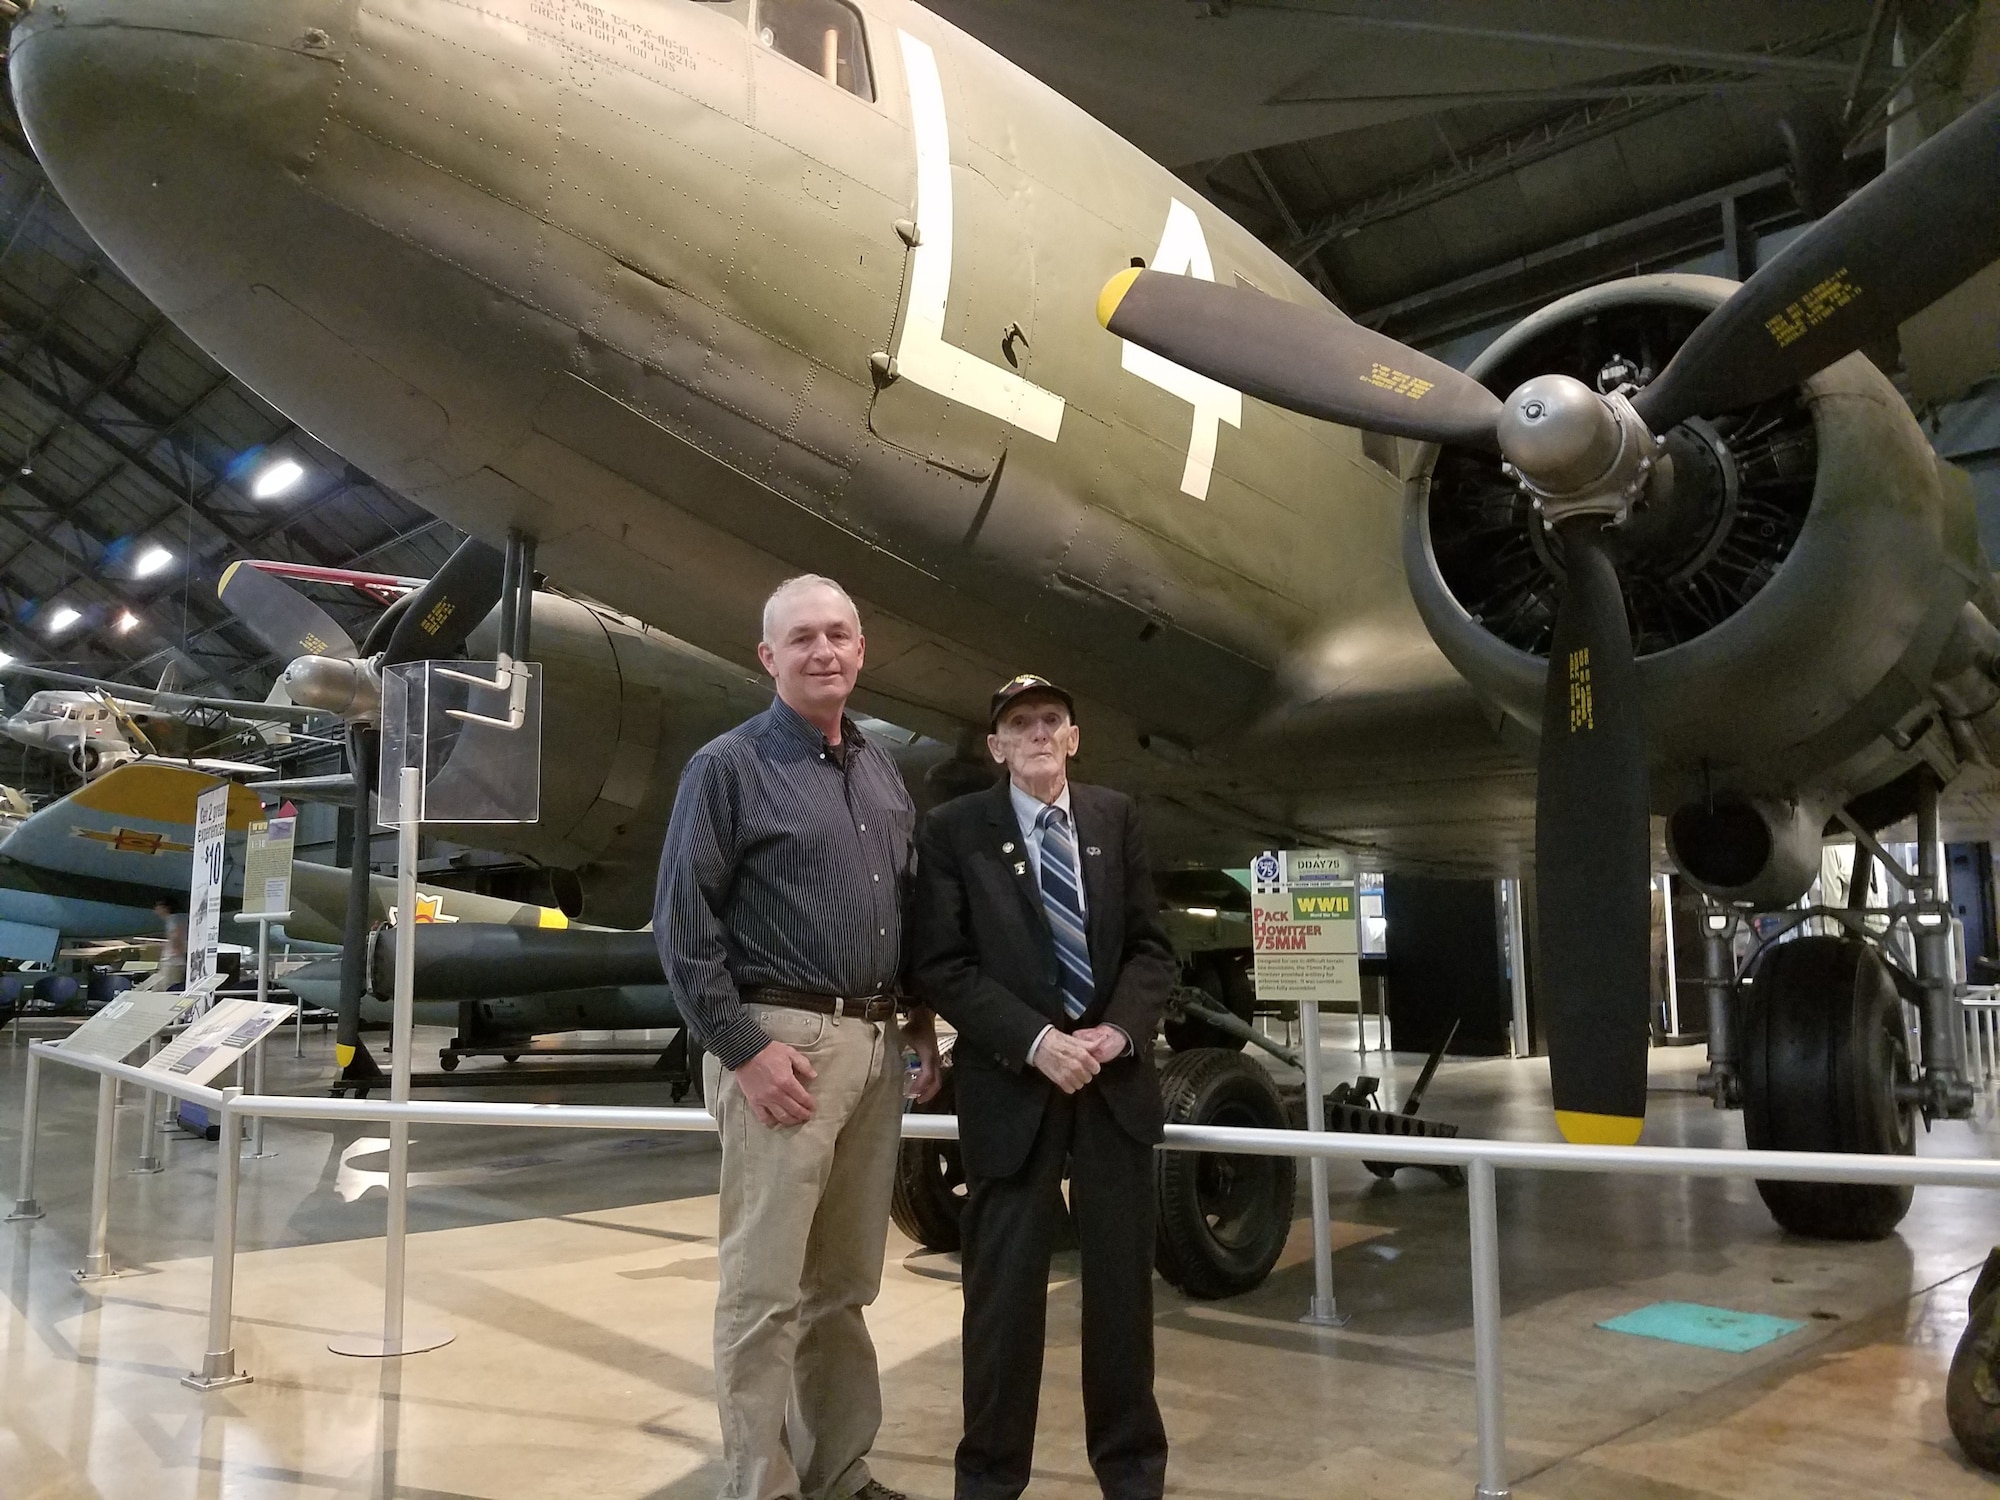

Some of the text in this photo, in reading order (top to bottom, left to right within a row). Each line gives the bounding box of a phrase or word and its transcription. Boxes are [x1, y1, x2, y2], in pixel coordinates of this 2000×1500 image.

[587, 14, 632, 41] SERIAL
[654, 55, 676, 72] LBS
[208, 803, 212, 822] 2
[205, 841, 221, 886] $10
[1297, 897, 1349, 912] WWII
[1253, 908, 1288, 921] PACK
[1255, 923, 1321, 936] HOWITZER
[1255, 936, 1307, 950] 75MM
